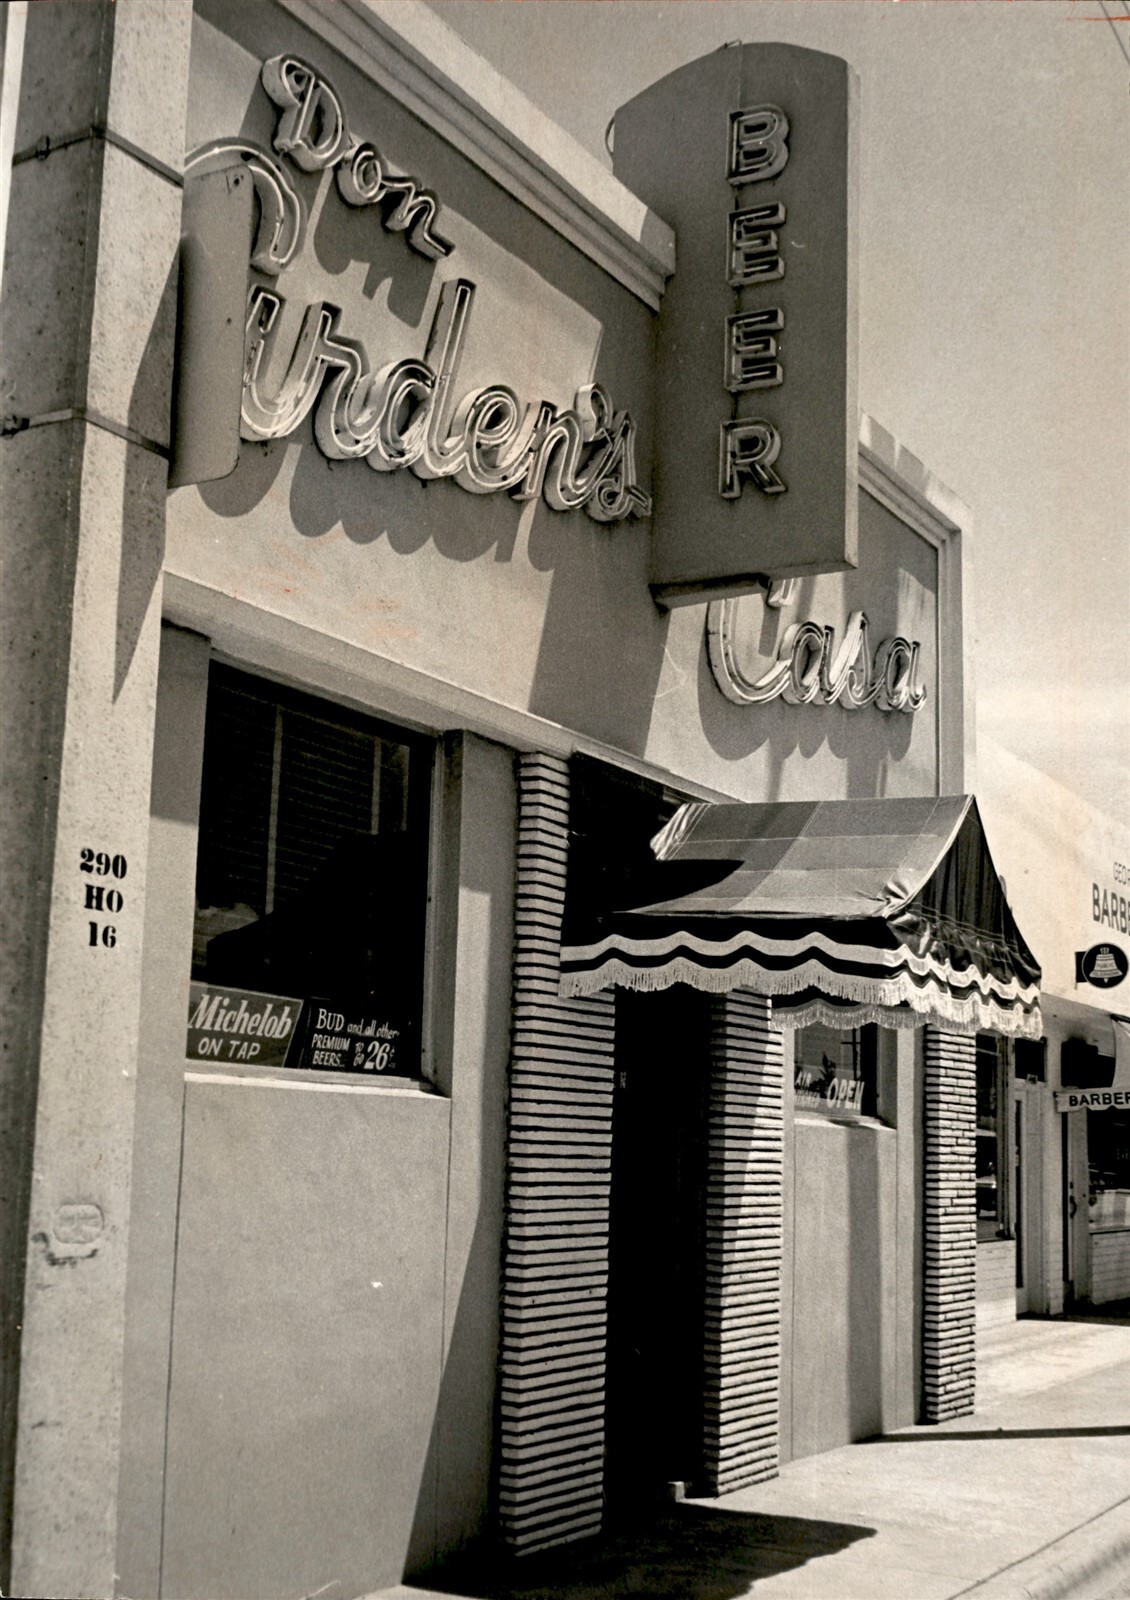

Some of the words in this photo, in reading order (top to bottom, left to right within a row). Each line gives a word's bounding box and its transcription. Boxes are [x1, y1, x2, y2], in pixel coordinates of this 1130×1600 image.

[262, 53, 455, 260] Don
[717, 103, 791, 501] BEER
[79, 847, 128, 880] 290
[1113, 861, 1130, 886] GEO
[1092, 882, 1130, 937] BARB
[88, 920, 117, 949] 16
[188, 993, 292, 1040] Michelob
[316, 1007, 345, 1031] BUD
[198, 1036, 223, 1056] ON
[228, 1040, 261, 1060] TAP
[311, 1033, 351, 1052] PREMIUM
[827, 1077, 865, 1111] OPEN
